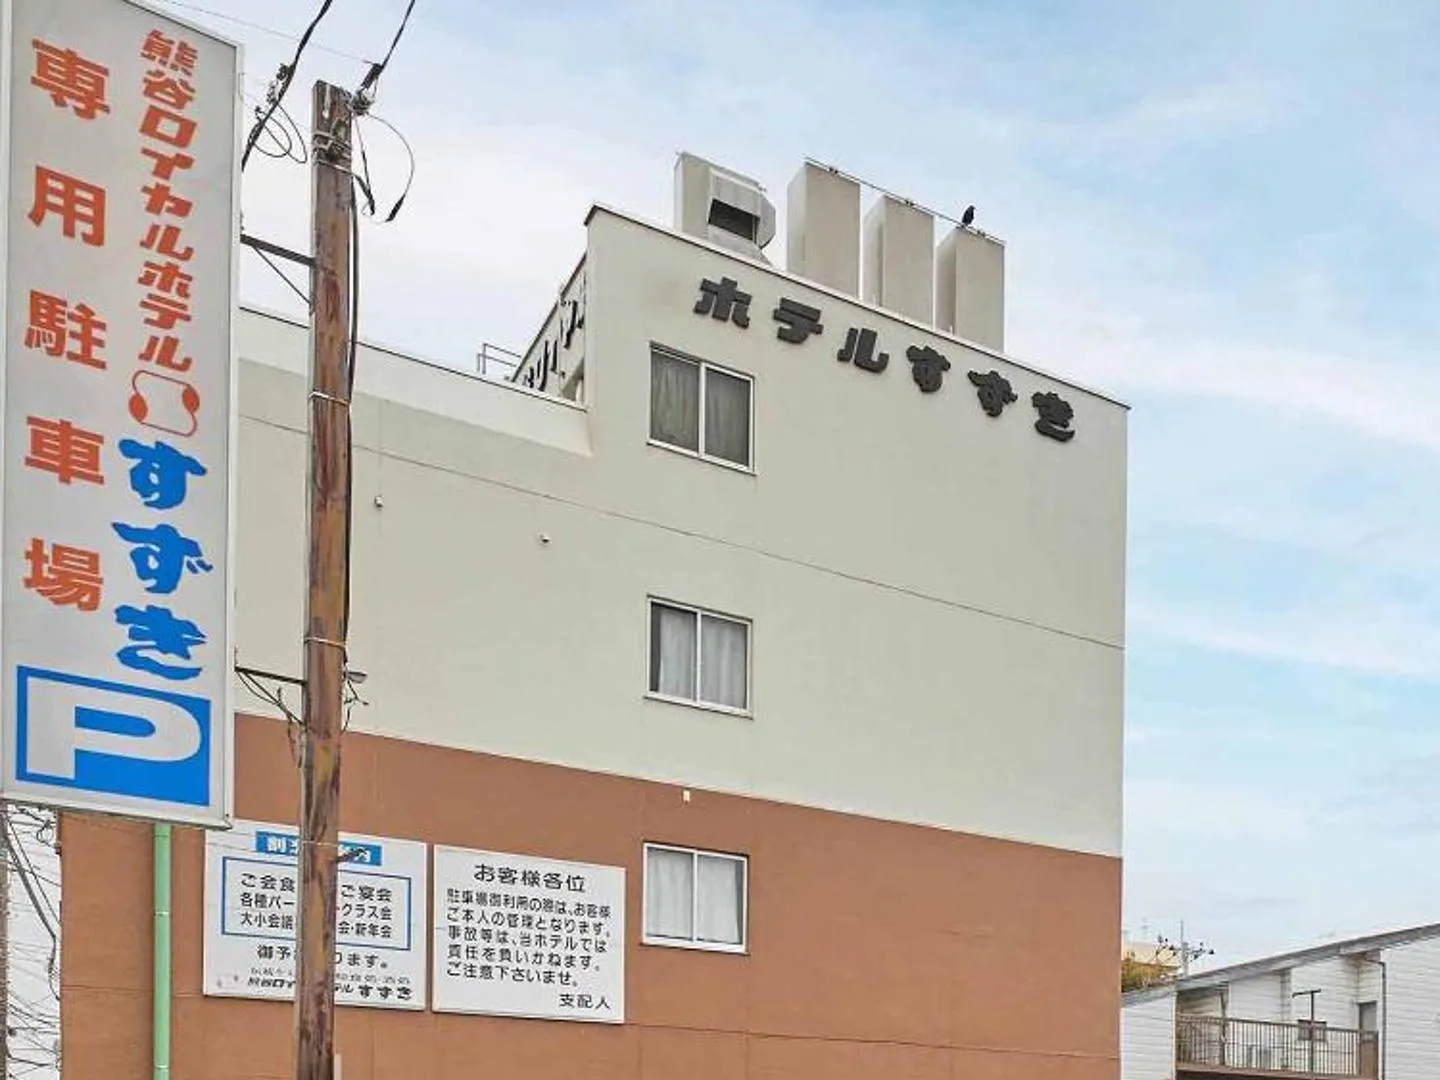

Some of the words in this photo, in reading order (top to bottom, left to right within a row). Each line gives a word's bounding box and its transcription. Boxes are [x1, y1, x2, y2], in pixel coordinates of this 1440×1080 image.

[137, 29, 199, 373] 熊谷ロイヤルホテル
[24, 38, 110, 612] 専用駐車場
[112, 437, 213, 681] すずき
[26, 676, 201, 780] P
[474, 864, 586, 893] お客様各位
[559, 993, 611, 1010] 支配人
